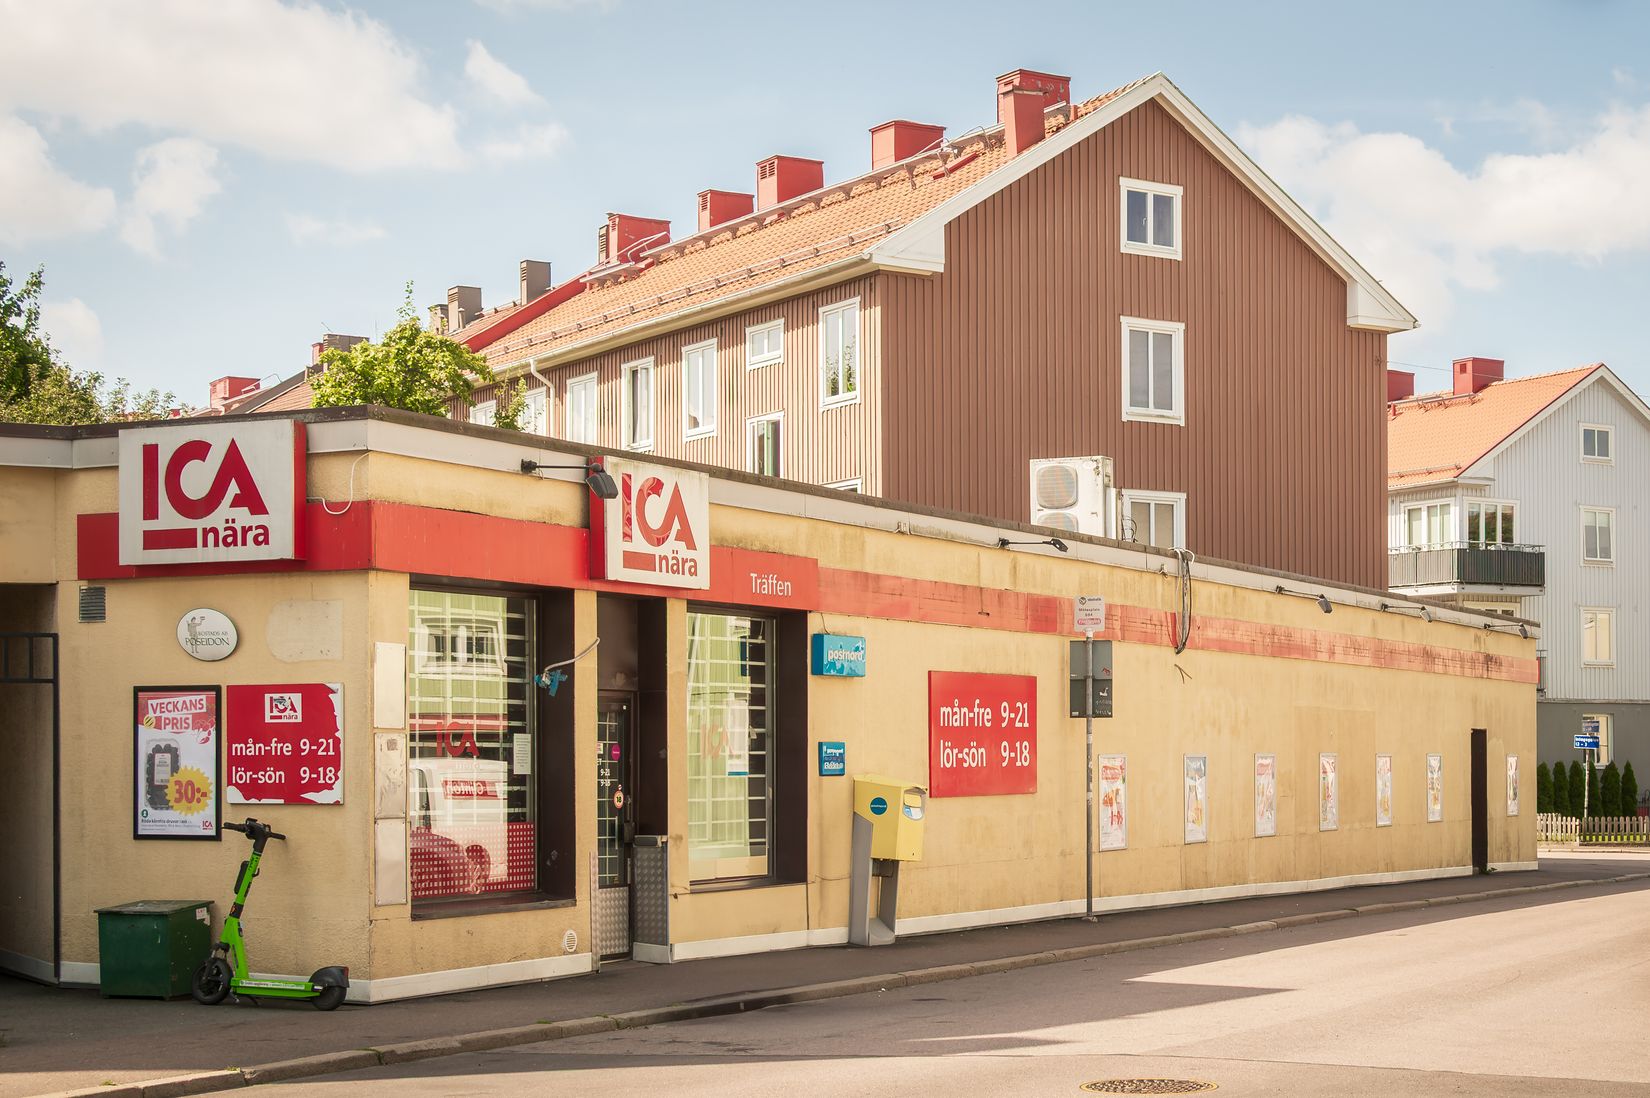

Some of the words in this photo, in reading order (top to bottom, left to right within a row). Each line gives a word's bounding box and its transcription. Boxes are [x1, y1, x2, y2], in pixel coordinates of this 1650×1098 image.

[142, 438, 269, 520] ICA
[621, 472, 698, 550] ICA
[202, 518, 270, 548] nära
[658, 550, 698, 577] nära
[750, 572, 792, 596] Träffen
[185, 637, 230, 646] POSEIDON
[150, 698, 204, 715] VECKANS
[940, 698, 992, 727] mån-fre
[1000, 701, 1029, 728] 9-21
[163, 716, 190, 730] PRIS
[232, 737, 292, 756] mån-fre
[300, 738, 335, 756] 9-21
[436, 721, 480, 757] ICA
[940, 739, 986, 768] lör-sön
[1000, 741, 1030, 767] 9-18
[232, 766, 285, 784] lör-sön
[300, 766, 336, 784] 9-18
[174, 779, 208, 804] 30:-
[202, 820, 213, 828] ICA
